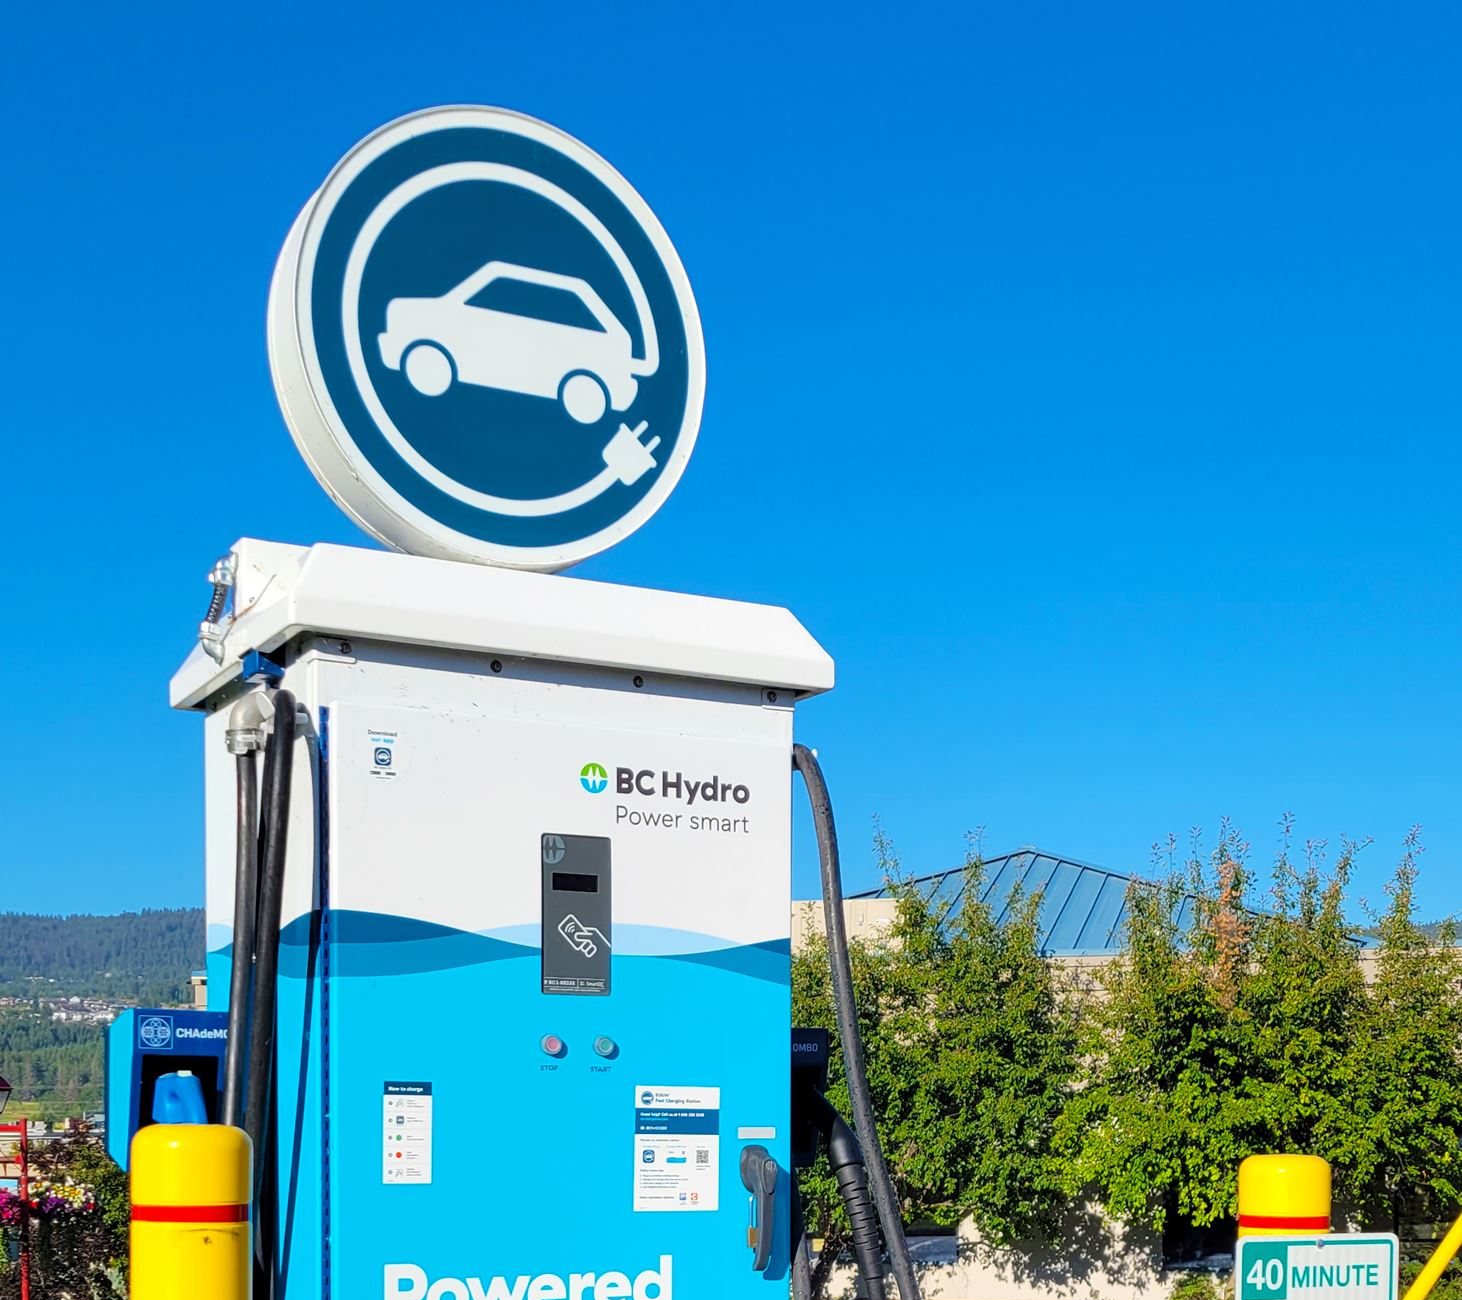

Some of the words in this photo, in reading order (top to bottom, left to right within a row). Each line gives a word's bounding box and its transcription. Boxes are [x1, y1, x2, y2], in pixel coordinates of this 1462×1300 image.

[367, 729, 398, 737] Download
[616, 766, 656, 796] BC
[662, 771, 750, 805] Hydro
[616, 805, 682, 828] Power
[690, 815, 749, 833] smart
[792, 1043, 819, 1052] OMBO
[1246, 1258, 1284, 1291] 40
[1291, 1264, 1379, 1288] MINUTE
